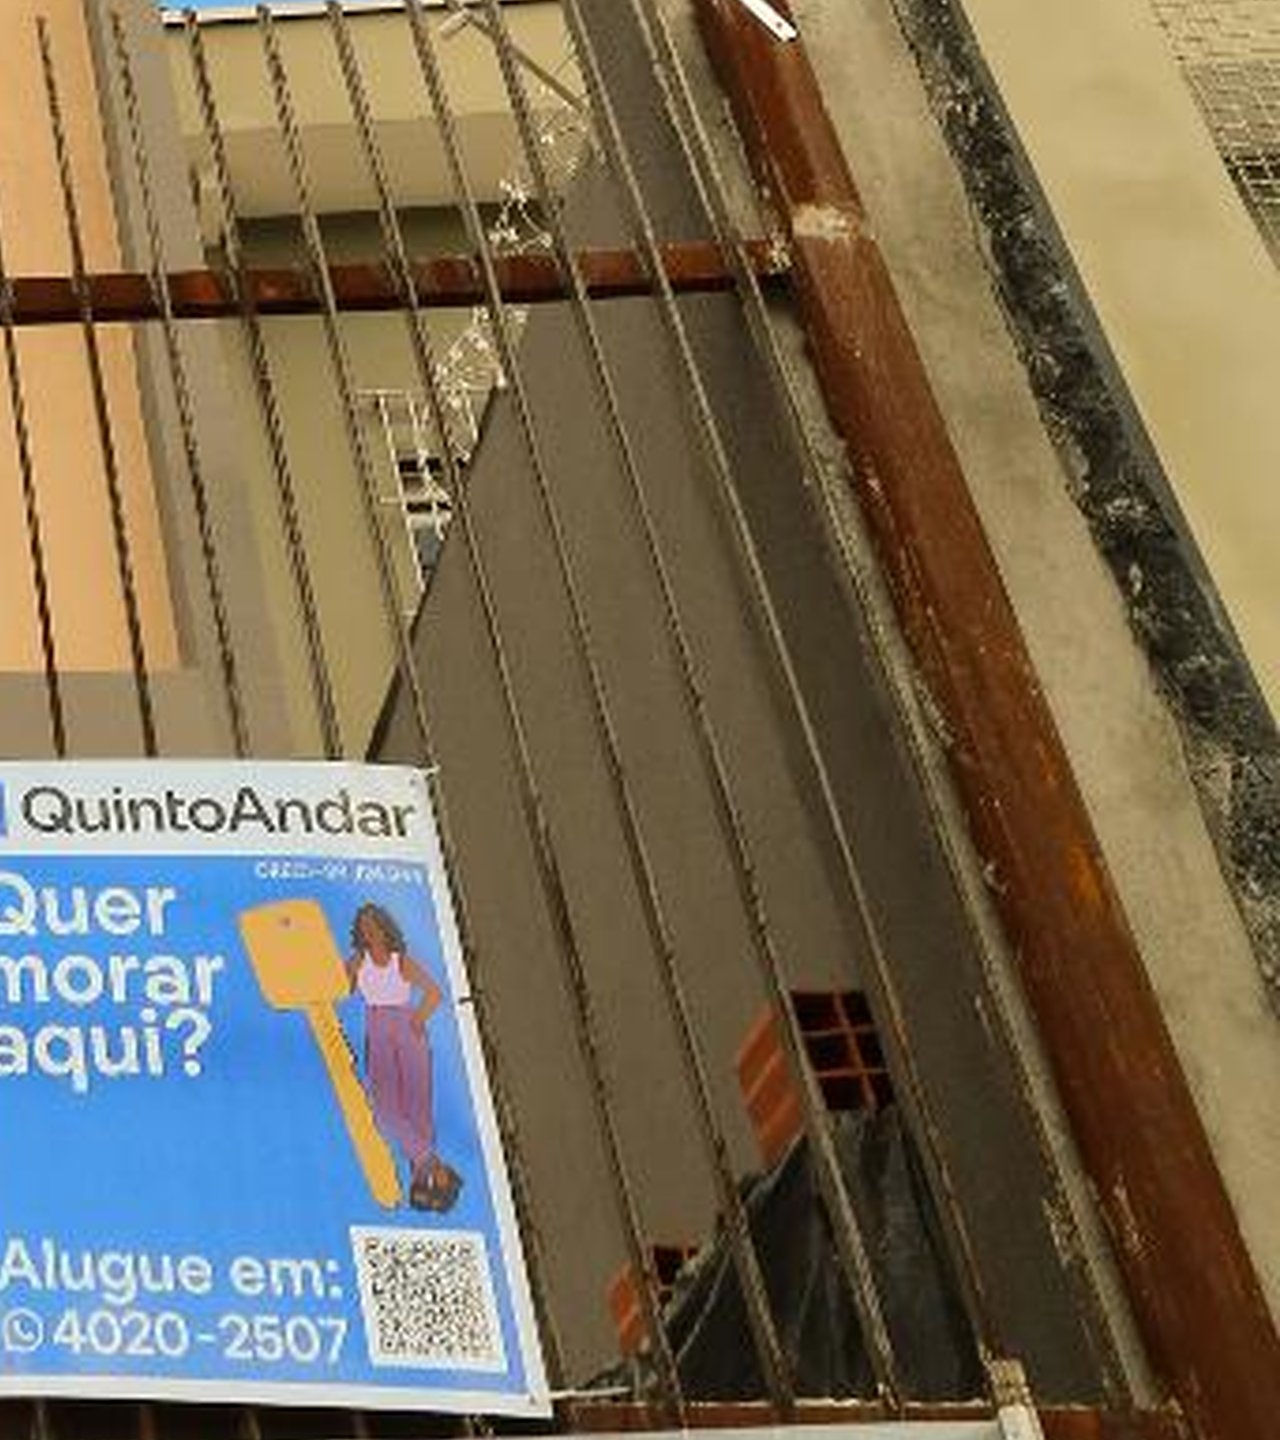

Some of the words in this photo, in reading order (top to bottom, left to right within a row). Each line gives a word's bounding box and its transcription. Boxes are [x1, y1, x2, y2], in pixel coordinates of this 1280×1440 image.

[21, 786, 416, 837] QuintoAndar
[230, 1256, 343, 1298] em:
[53, 1308, 348, 1363] 4020-2507
